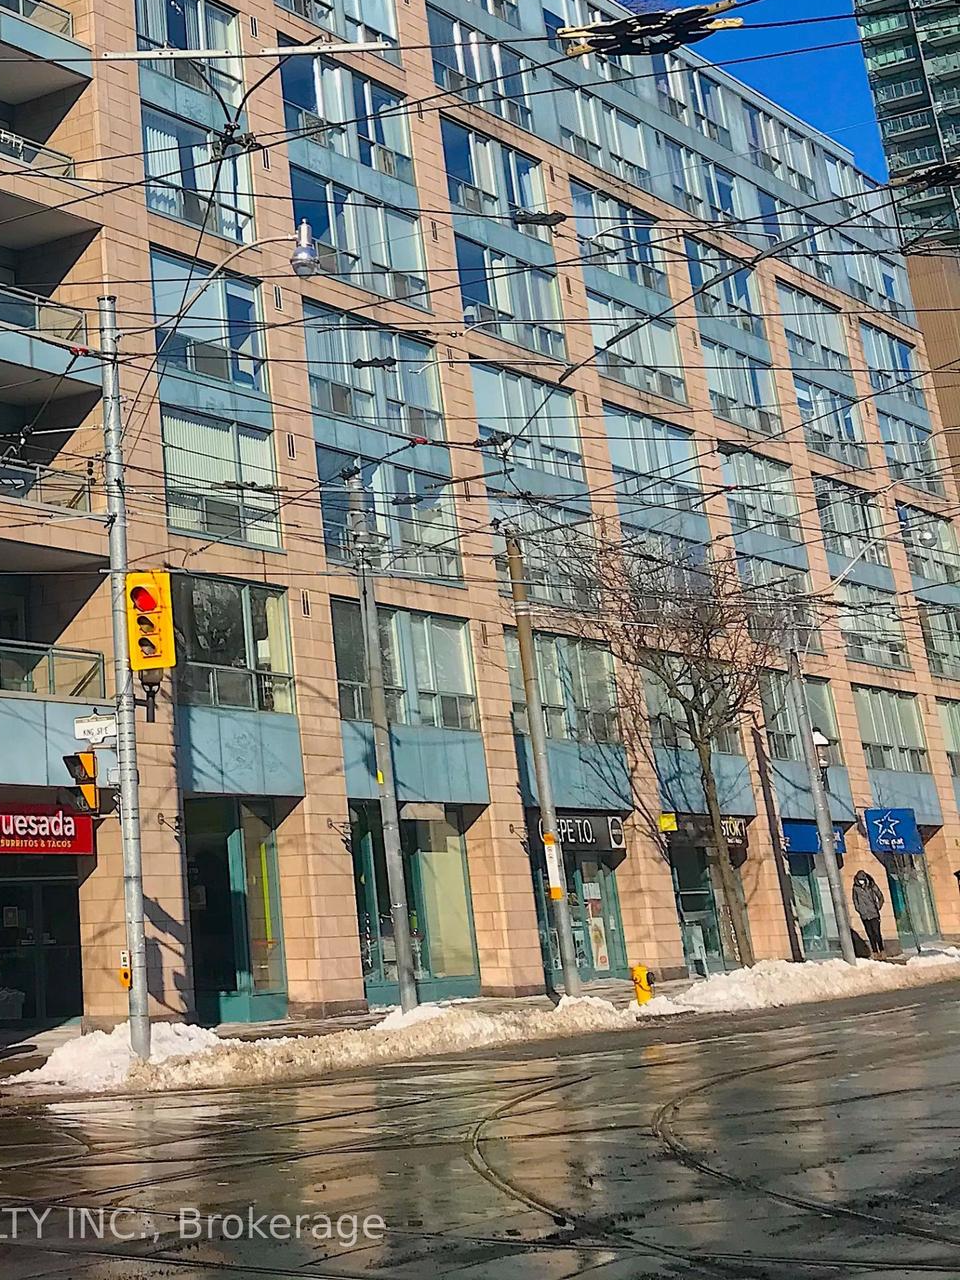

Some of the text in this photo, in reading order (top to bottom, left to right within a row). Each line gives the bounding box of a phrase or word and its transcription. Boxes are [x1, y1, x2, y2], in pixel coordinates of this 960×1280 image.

[0, 839, 72, 848] BURRITOS & TACOS
